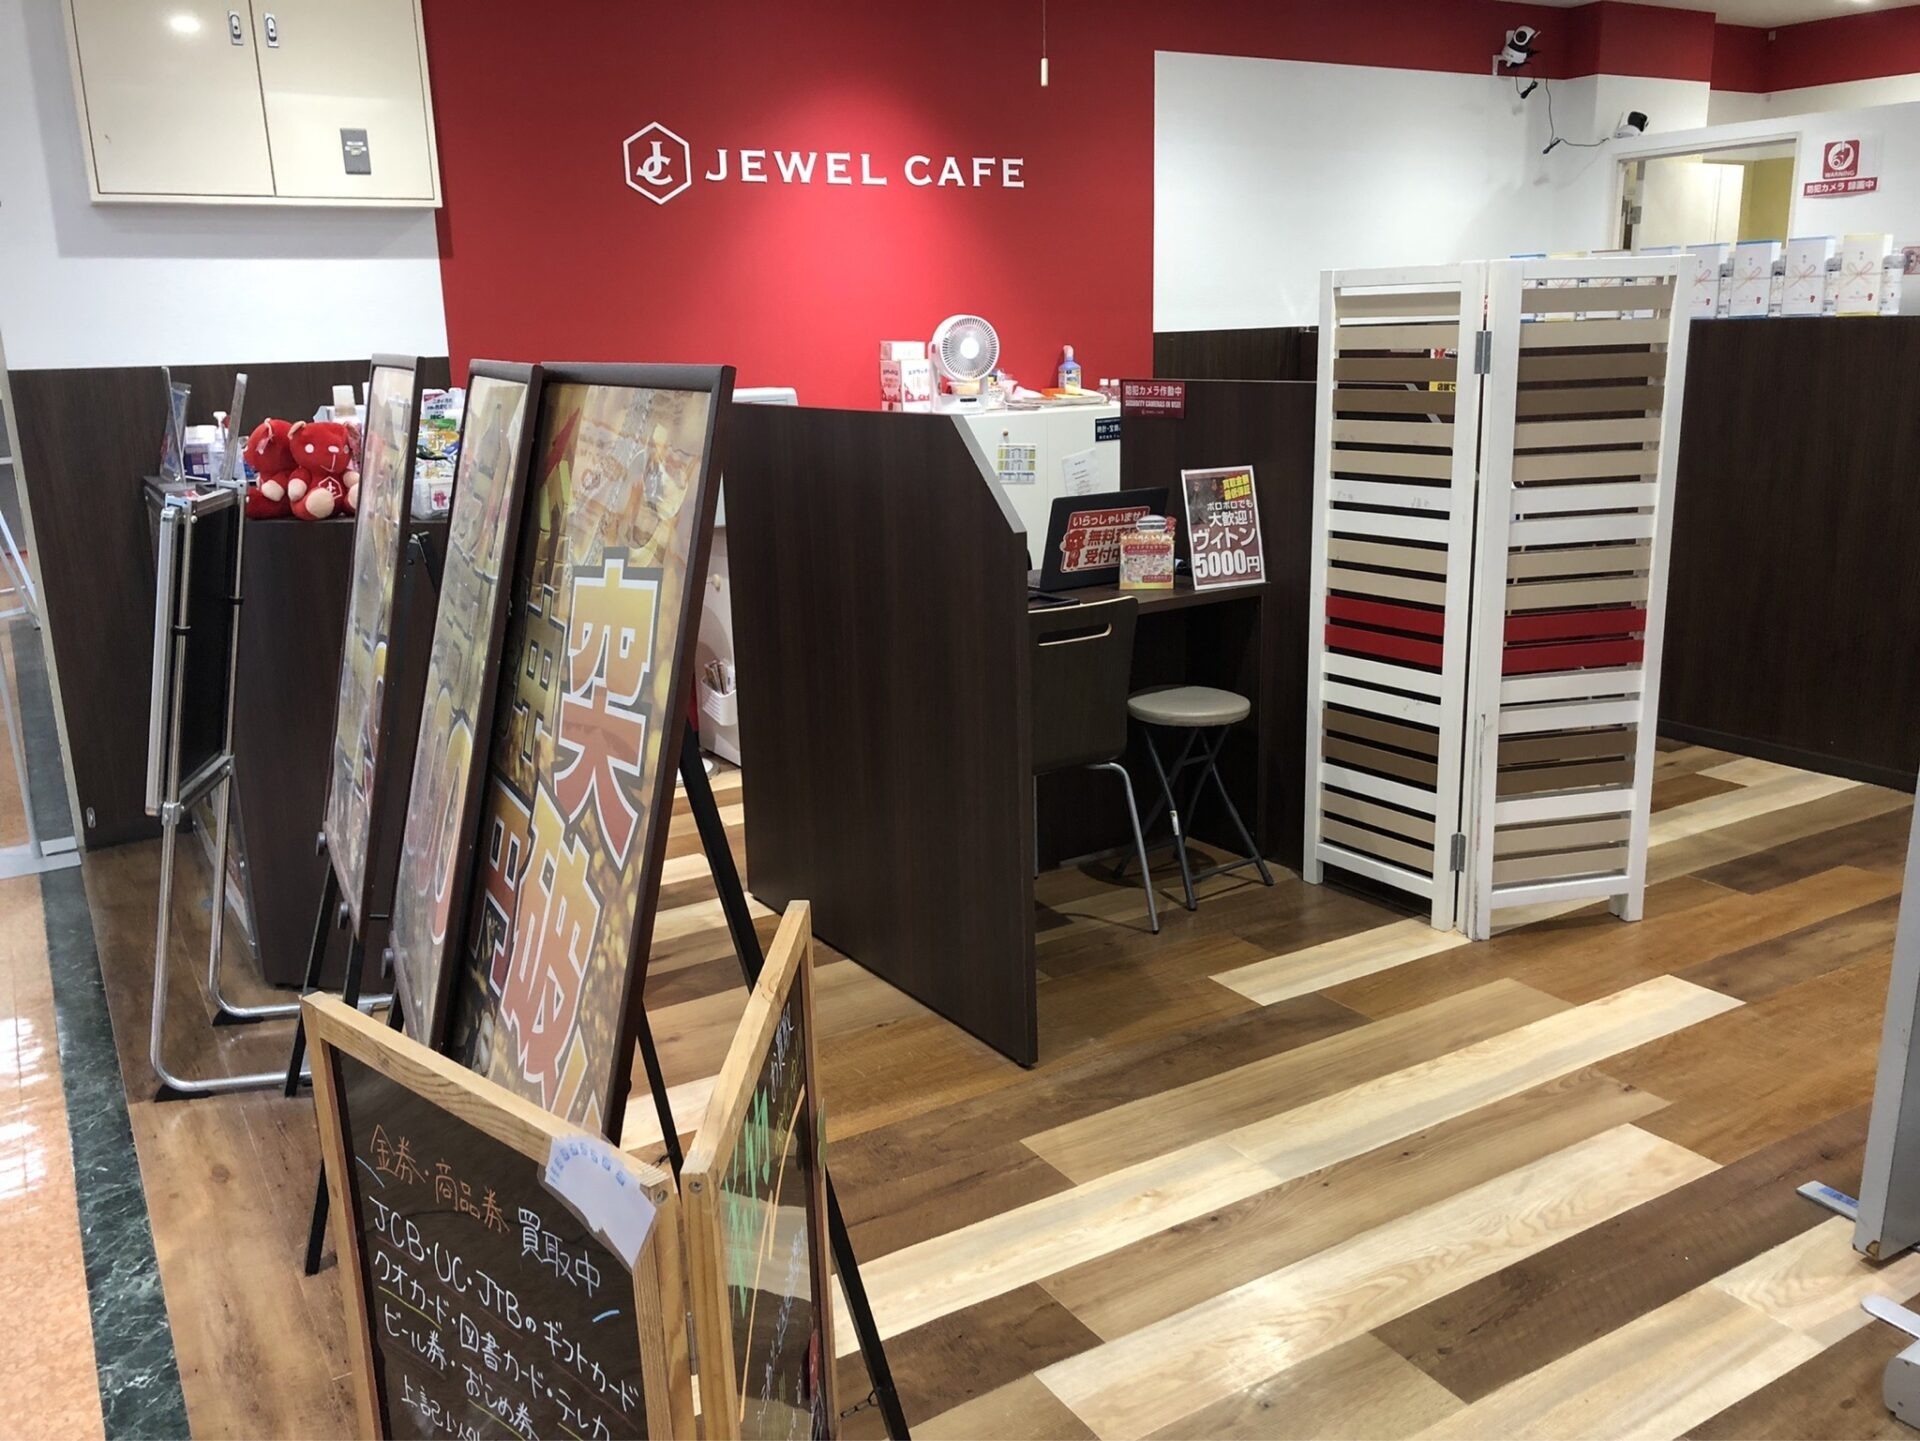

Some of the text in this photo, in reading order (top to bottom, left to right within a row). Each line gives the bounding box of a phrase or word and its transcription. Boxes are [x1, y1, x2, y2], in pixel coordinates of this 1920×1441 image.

[705, 148, 888, 186] JEWEL
[904, 154, 1026, 189] CAFE
[1125, 384, 1183, 397] 防犯カメラ作動中
[1192, 527, 1256, 551] ヴィトン
[1194, 549, 1261, 578] 5000円
[517, 1206, 601, 1298] 買取中
